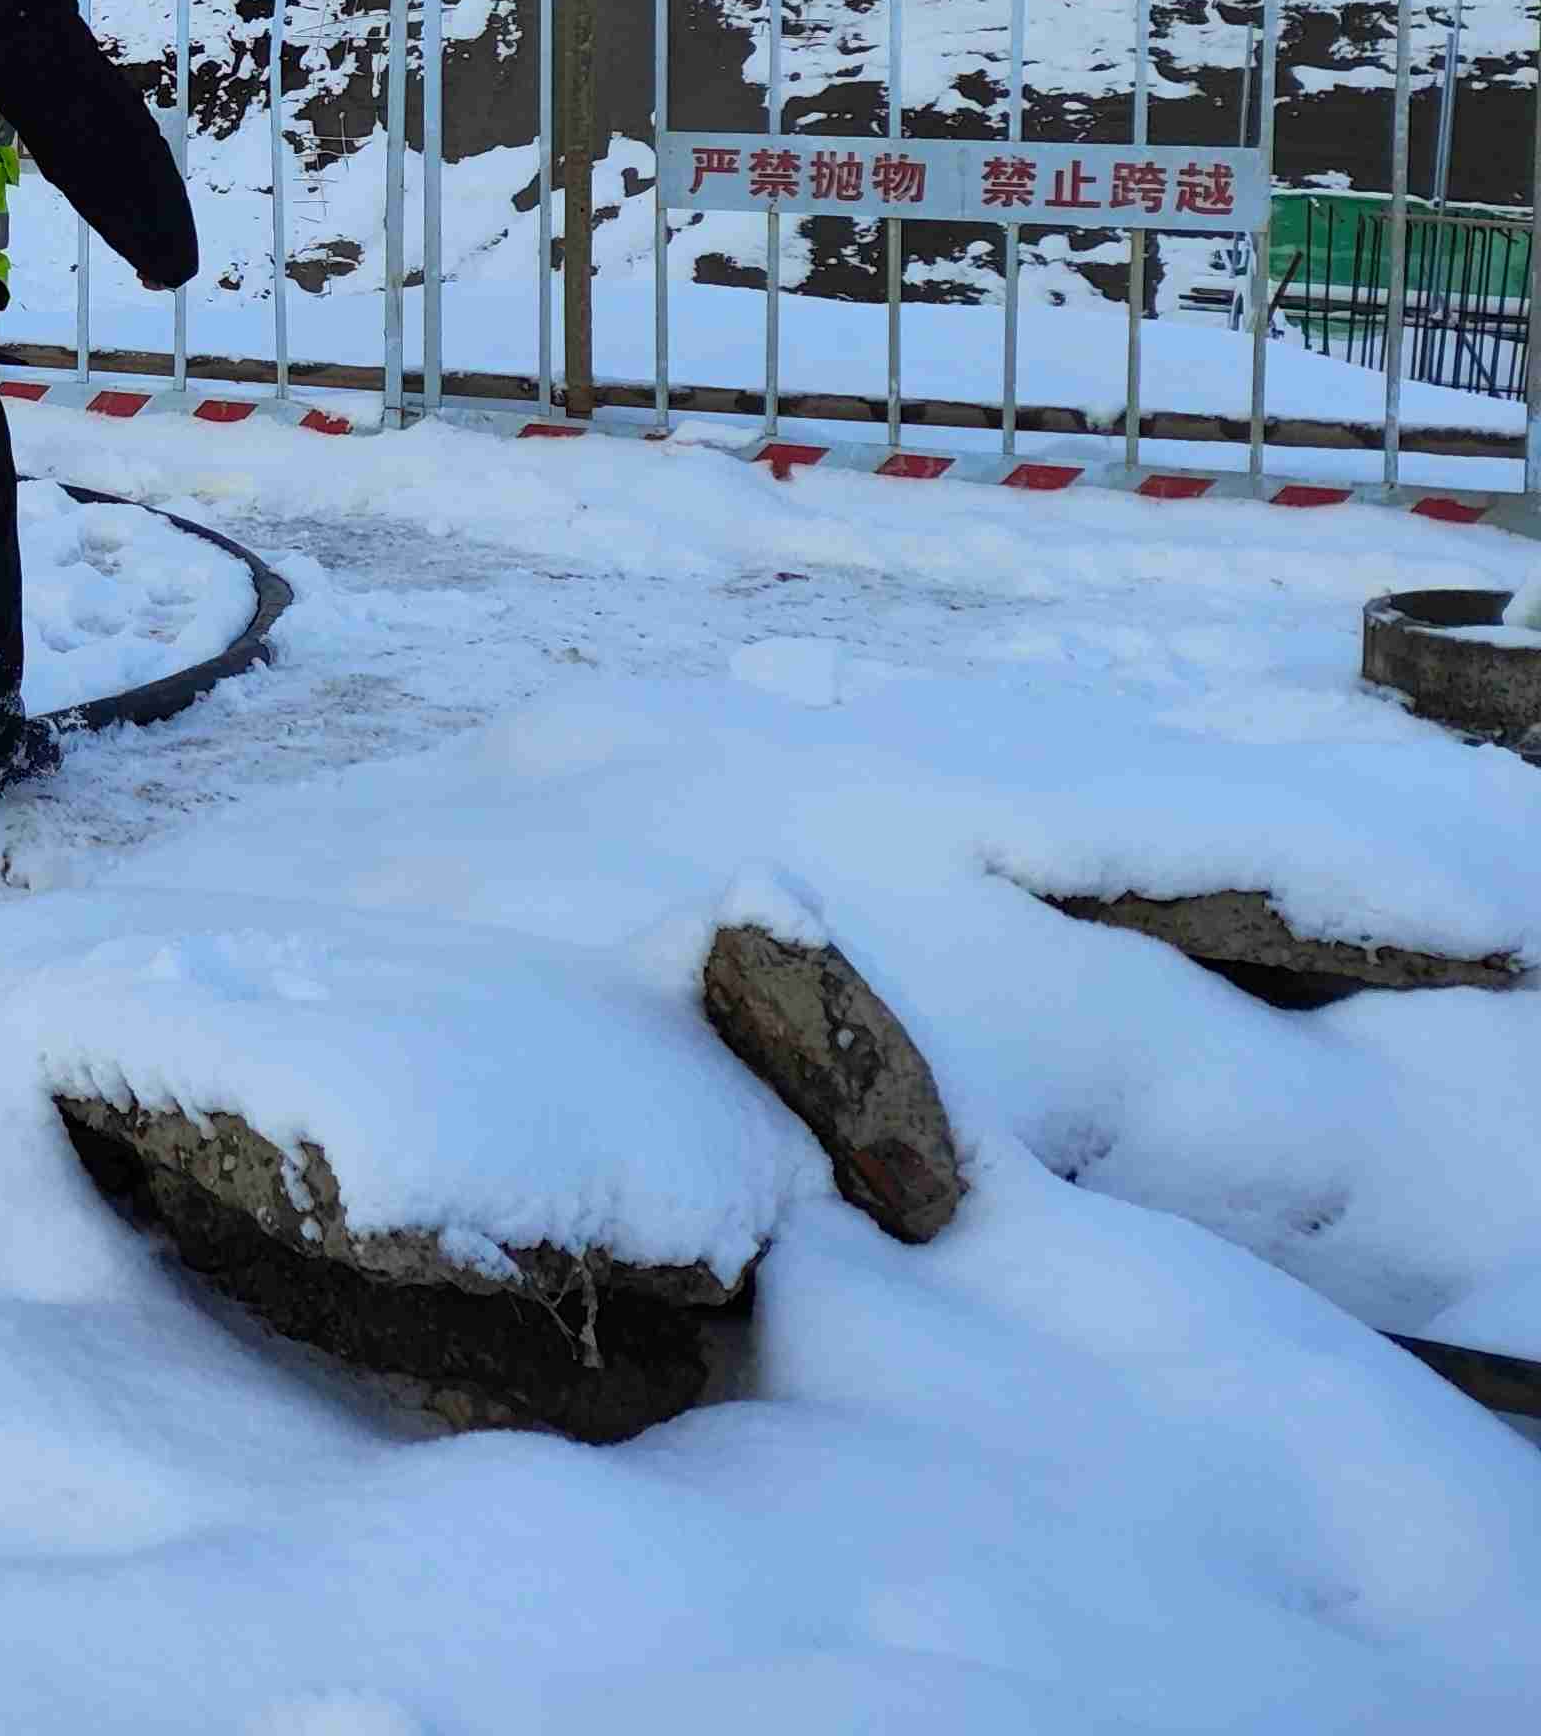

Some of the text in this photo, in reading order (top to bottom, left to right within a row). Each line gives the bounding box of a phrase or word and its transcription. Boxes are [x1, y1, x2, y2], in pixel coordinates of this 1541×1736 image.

[688, 147, 1234, 216] 严禁抛物 禁止跨越
